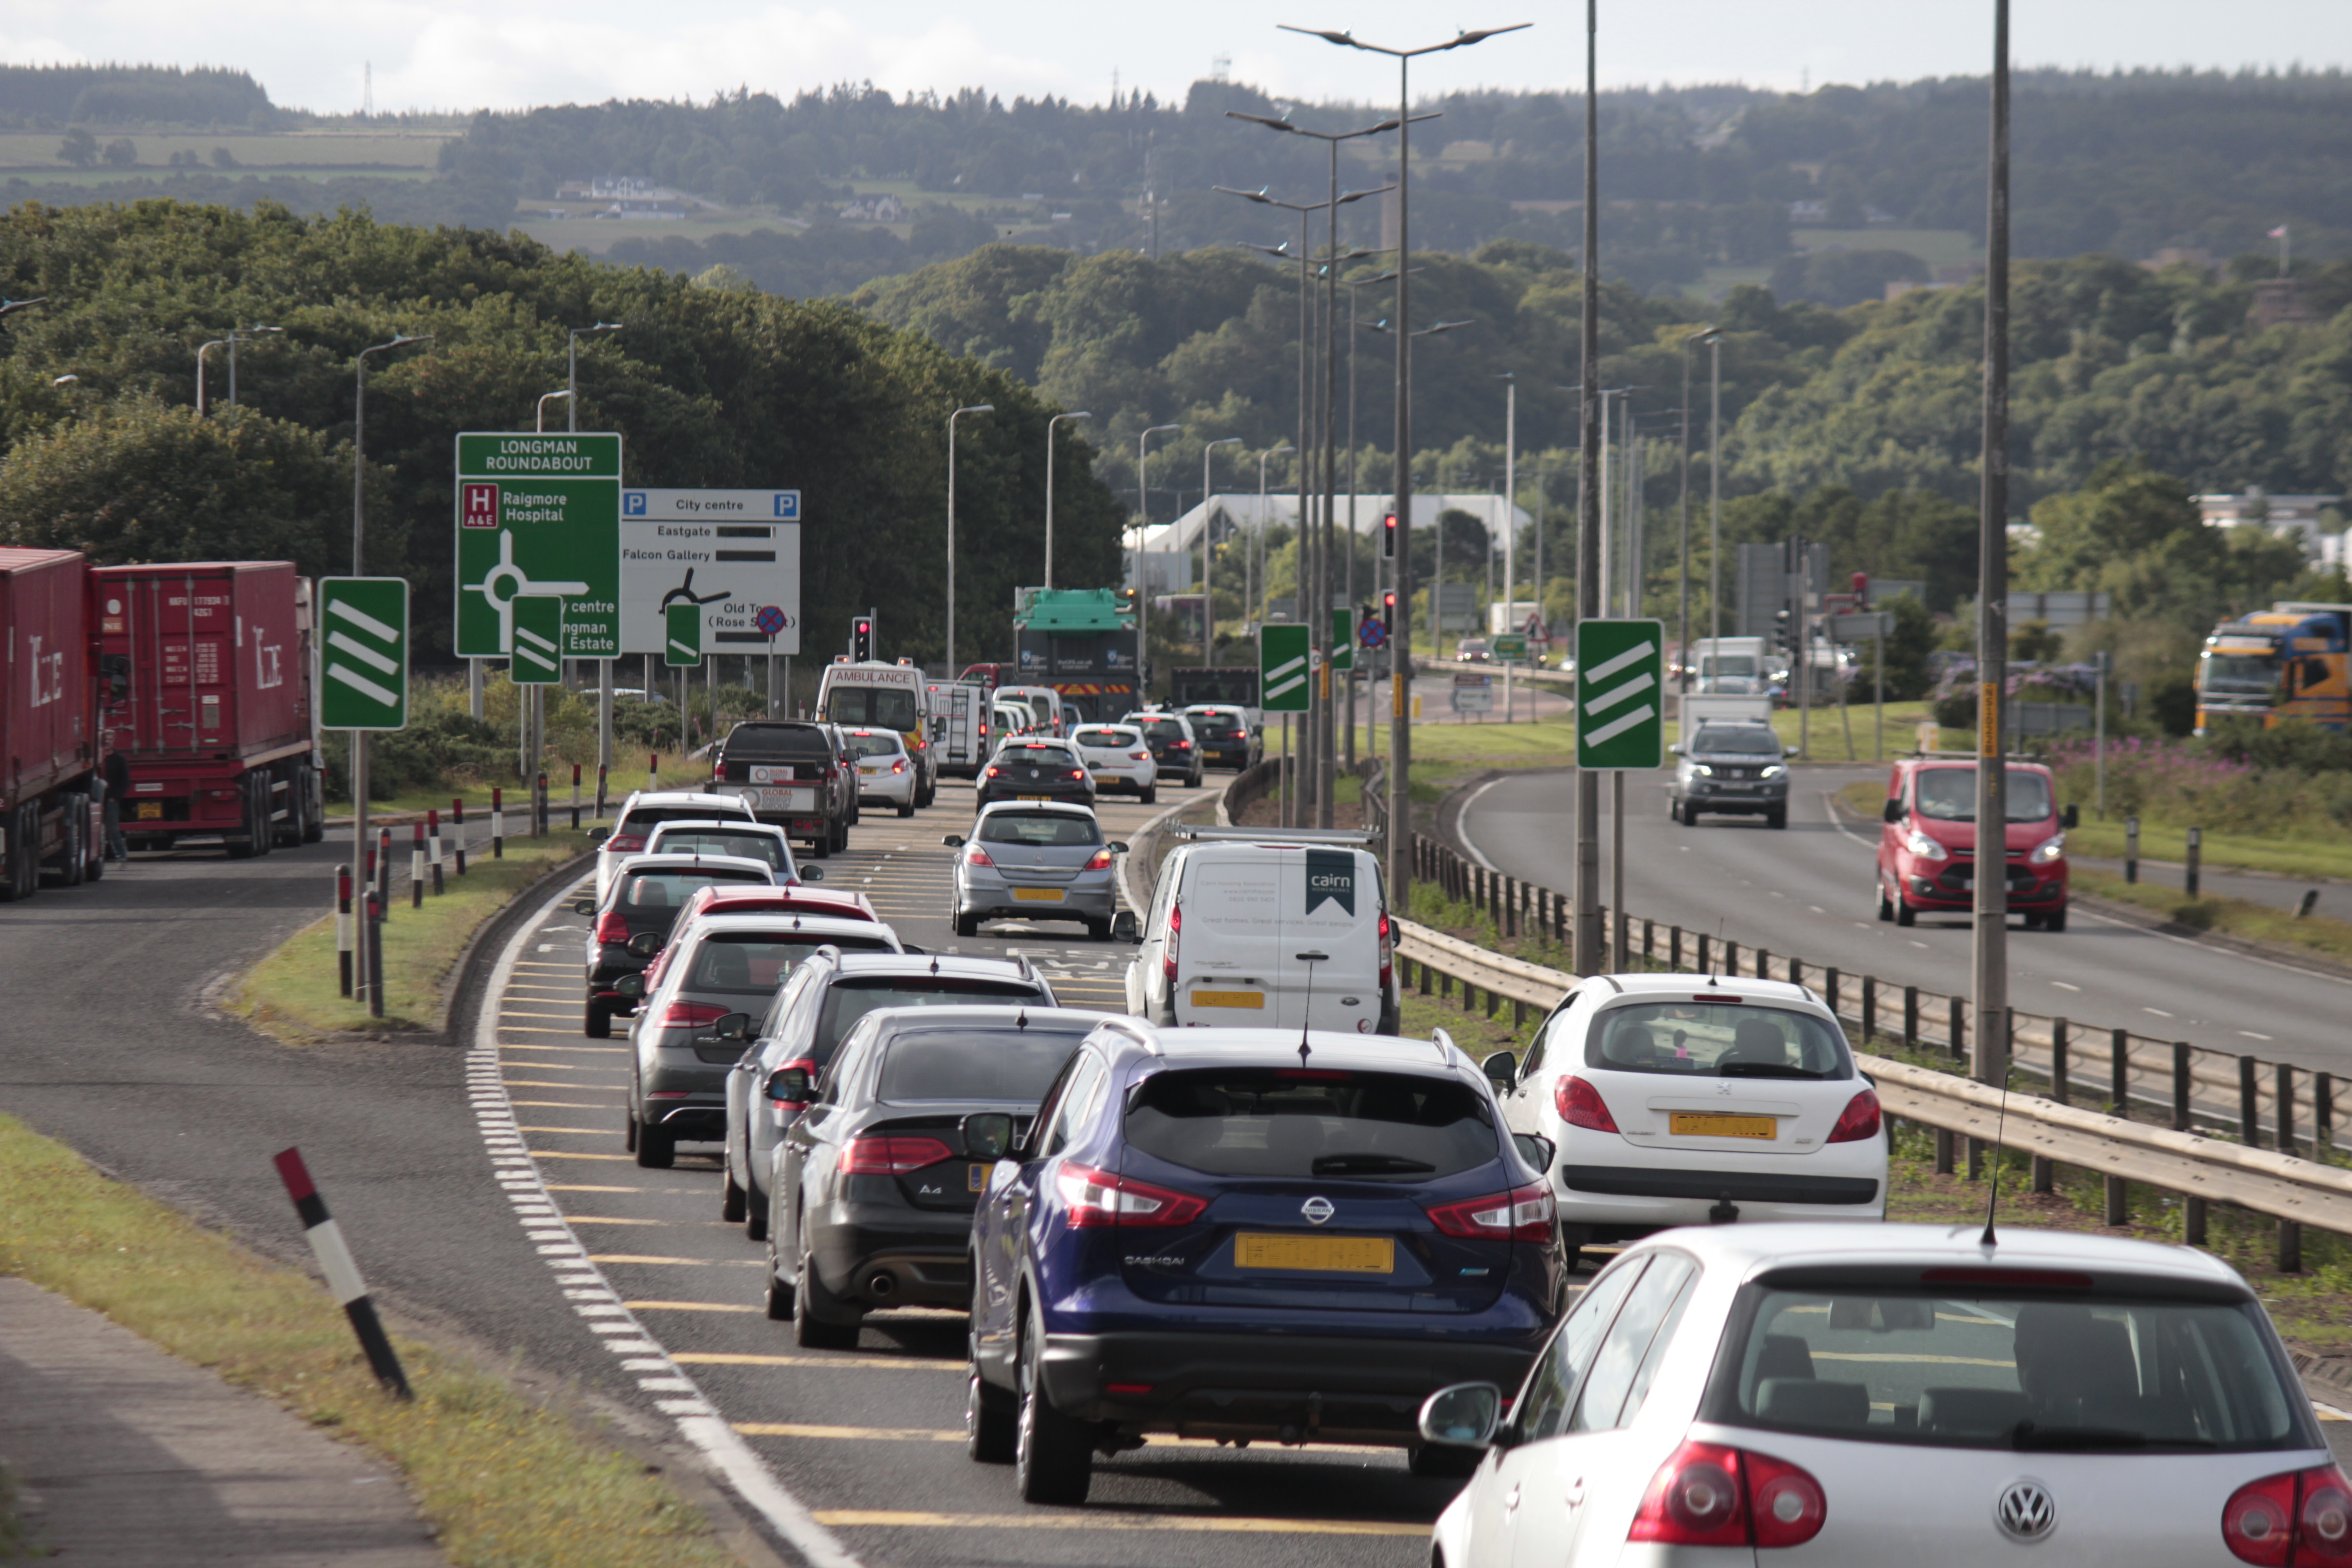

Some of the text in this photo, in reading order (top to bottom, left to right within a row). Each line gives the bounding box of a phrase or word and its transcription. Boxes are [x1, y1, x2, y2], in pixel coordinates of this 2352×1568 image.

[501, 441, 577, 453] LONGMAN
[486, 456, 592, 470] ROUNDABOUT
[472, 489, 490, 511] H
[503, 492, 567, 507] Raigmore
[629, 495, 643, 514] P
[676, 500, 743, 512] City centre
[779, 496, 793, 515] P
[506, 509, 564, 523] Hospital
[658, 525, 710, 537] Eastgate
[623, 549, 710, 562] Falcon Gallery
[572, 600, 614, 613] centre
[724, 603, 745, 613] Old
[563, 623, 607, 636] ngman
[570, 636, 614, 650] Estate
[836, 671, 910, 684] AMBULANCE
[1311, 873, 1351, 887] cairn
[919, 1184, 942, 1195] A4
[1124, 1256, 1185, 1266] QASHQAI
